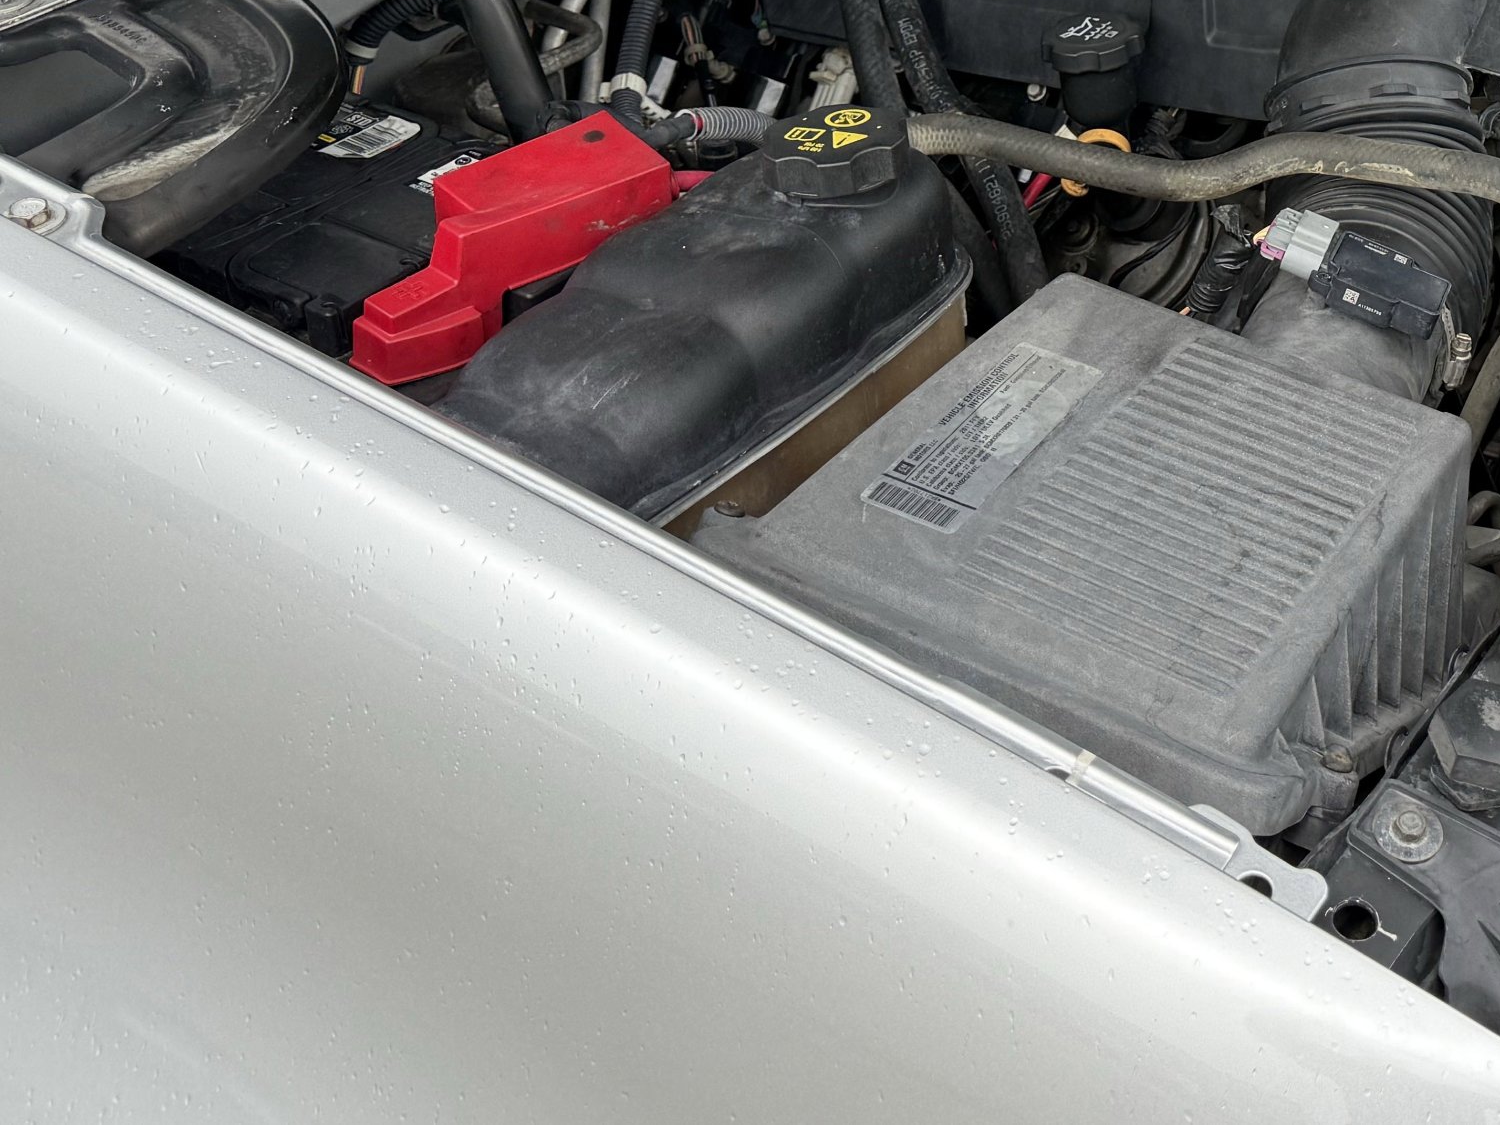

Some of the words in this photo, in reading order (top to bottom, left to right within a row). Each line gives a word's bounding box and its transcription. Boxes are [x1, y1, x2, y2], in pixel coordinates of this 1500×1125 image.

[897, 16, 919, 46] EPDM
[938, 402, 966, 425] VEHICLE
[962, 376, 993, 402] EMISSION
[989, 352, 1018, 376] CONTROL
[967, 371, 1008, 408] INFORMATION
[906, 442, 926, 458] GENERAL
